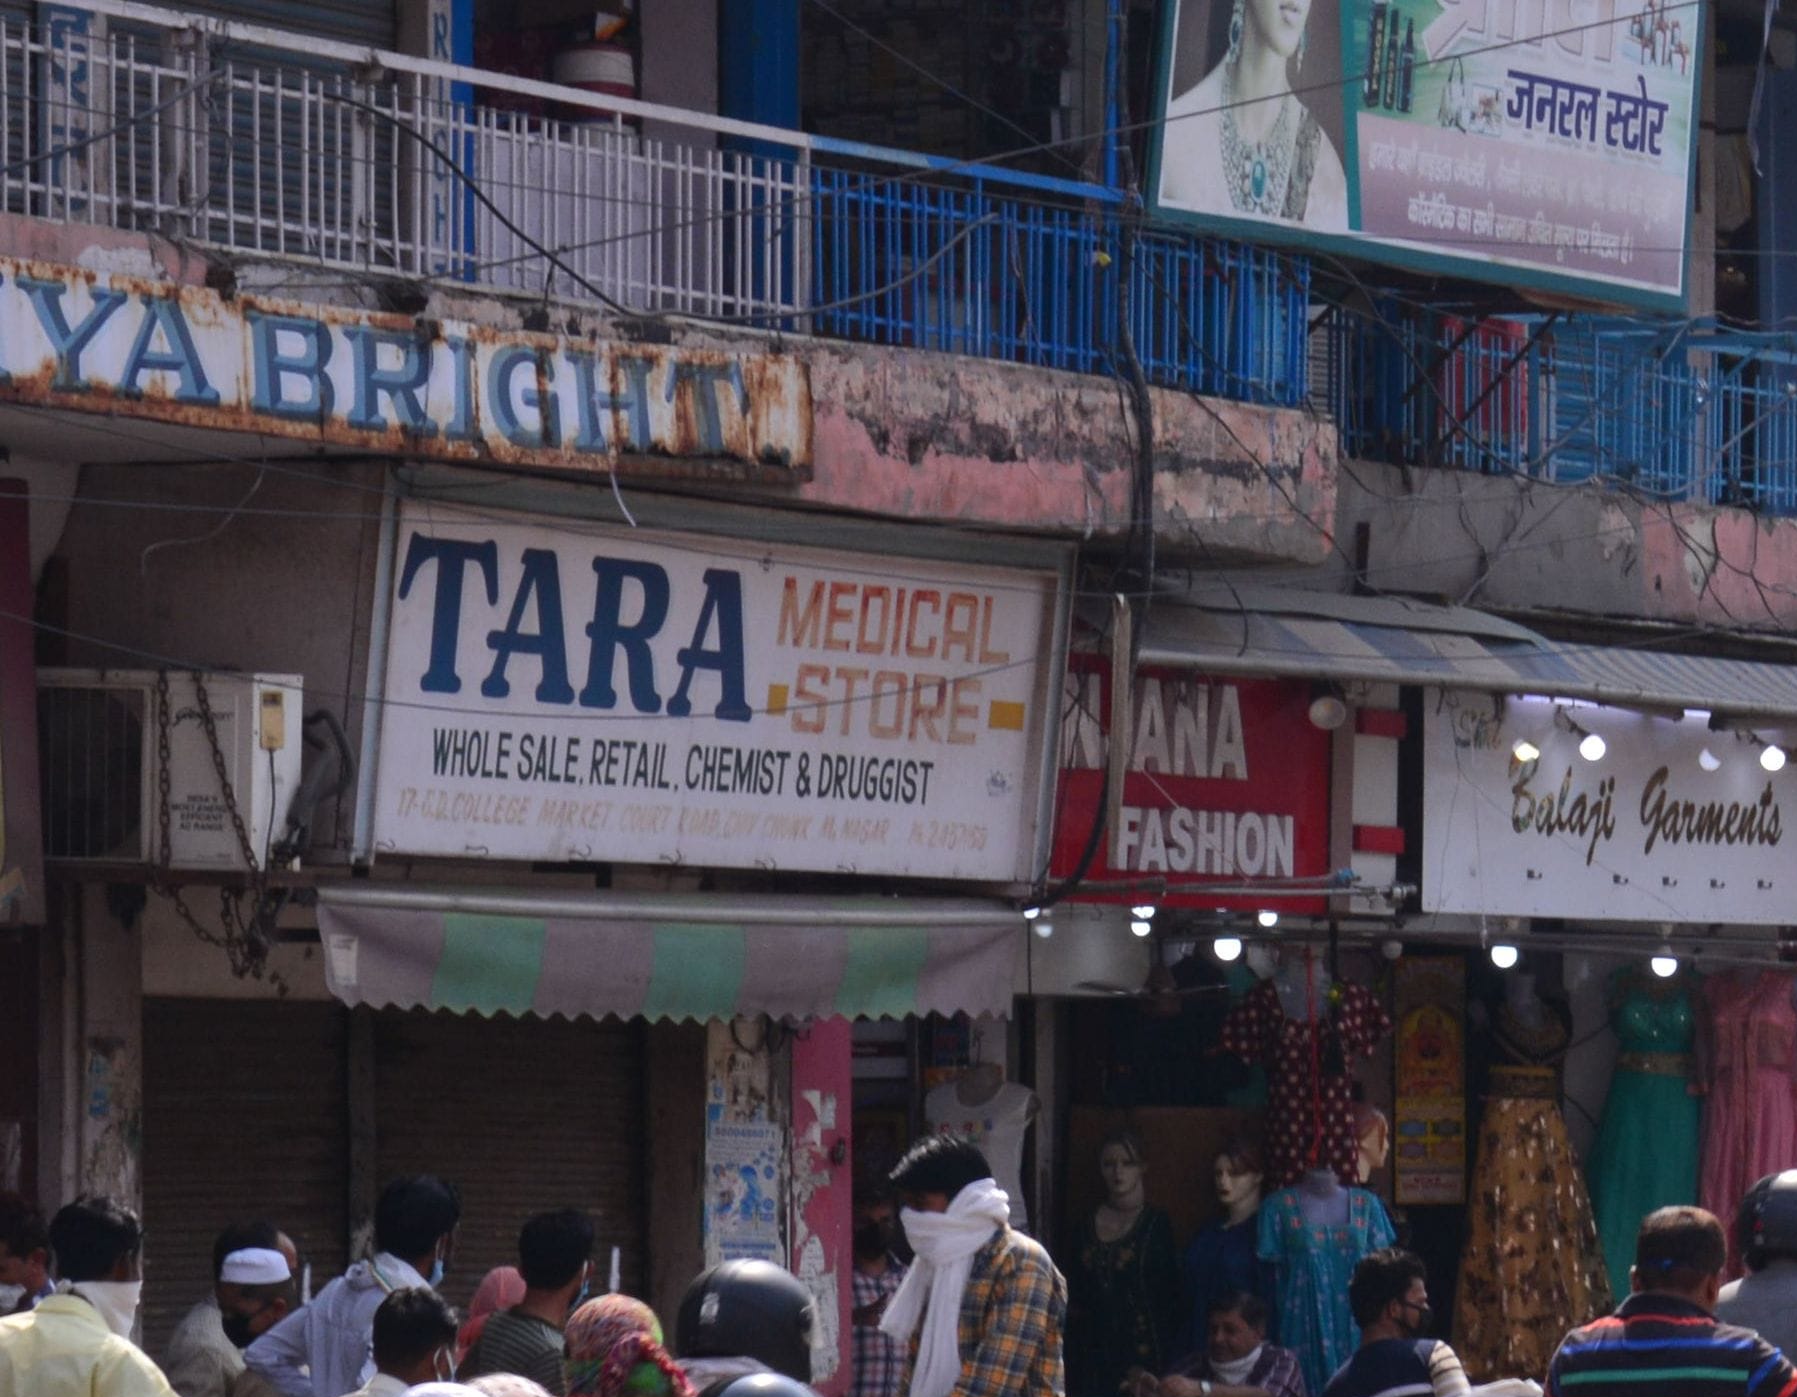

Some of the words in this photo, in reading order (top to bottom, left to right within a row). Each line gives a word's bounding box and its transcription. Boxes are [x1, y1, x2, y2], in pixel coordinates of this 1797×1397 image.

[1507, 70, 1601, 142] जनरल
[1605, 75, 1669, 156] स्टोर
[249, 309, 749, 453] BRIGHT
[400, 531, 752, 722] TARA
[776, 576, 1010, 665] MEDICAL
[791, 663, 983, 747] STORE
[433, 728, 512, 779] WHOLE
[685, 745, 791, 797] CHEMIST
[796, 753, 810, 798] &
[817, 755, 934, 806] DRUGGIST
[1508, 752, 1617, 868] Balaji
[1639, 765, 1784, 856] Garments
[1117, 805, 1294, 878] FASHION
